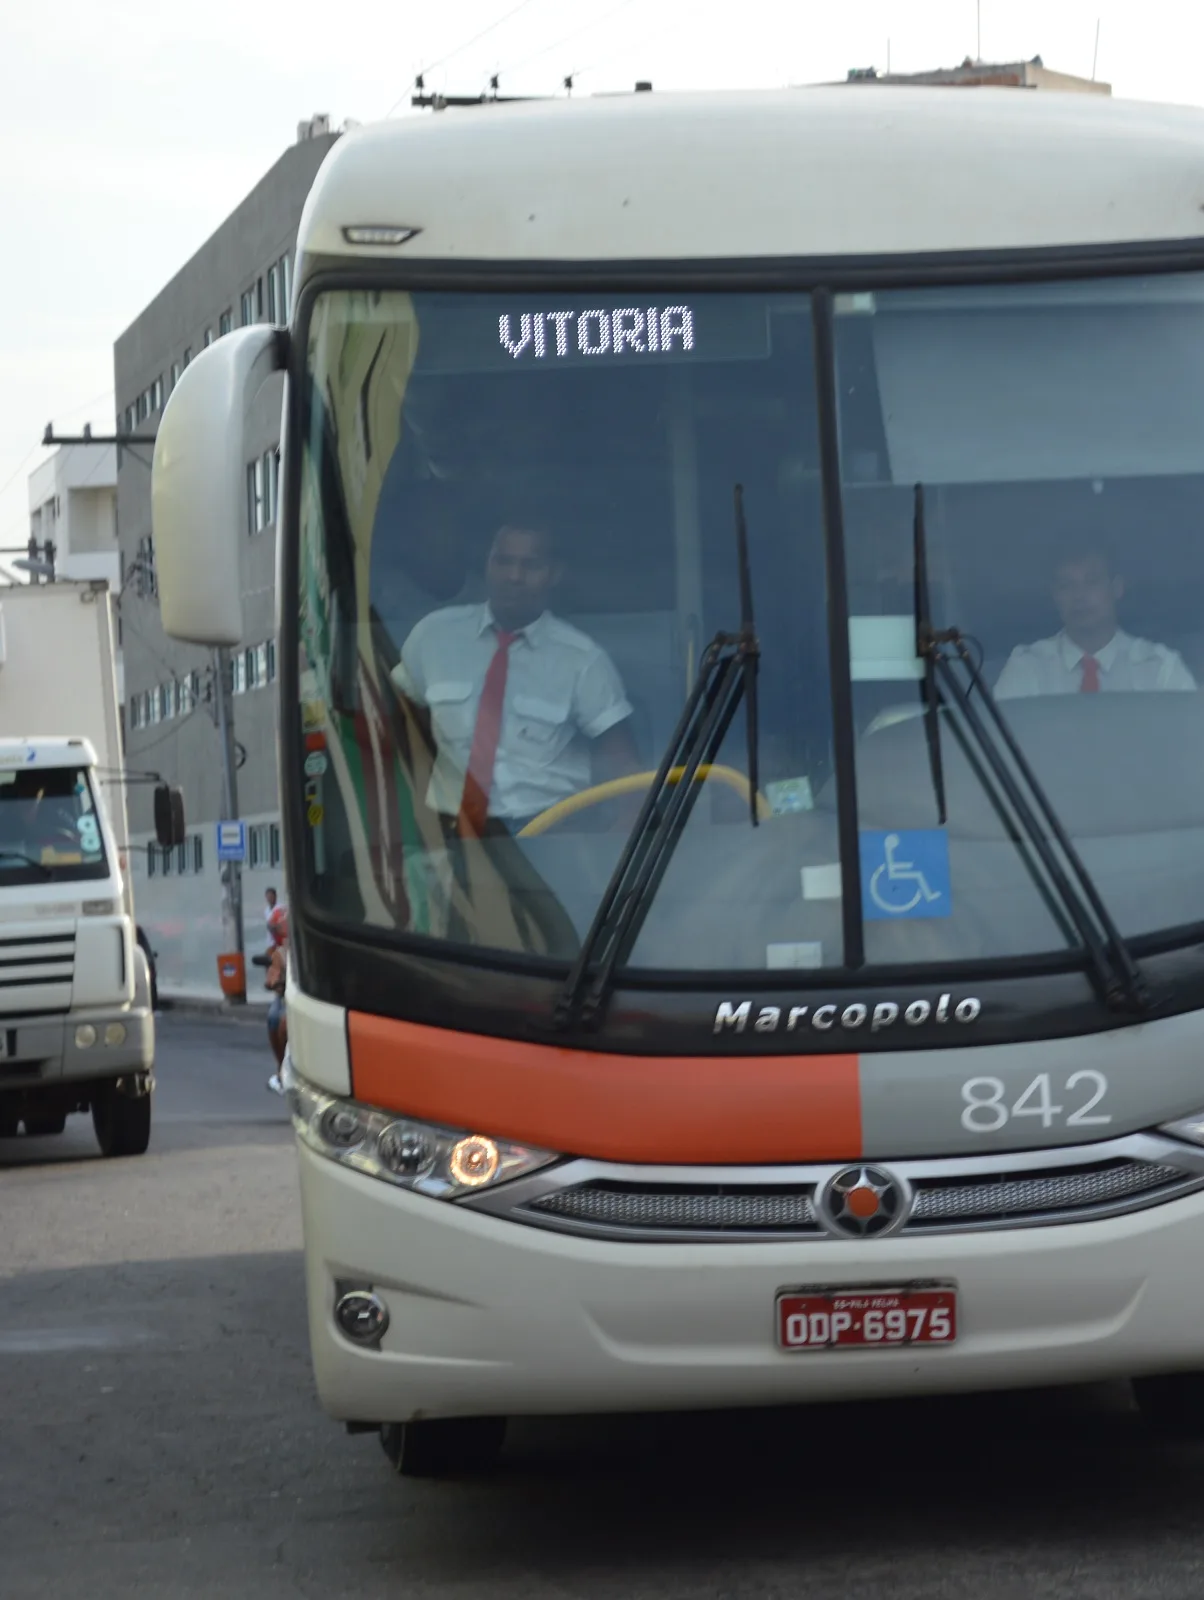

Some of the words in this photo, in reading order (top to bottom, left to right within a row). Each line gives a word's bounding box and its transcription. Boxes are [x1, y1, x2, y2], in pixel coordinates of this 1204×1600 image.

[499, 305, 694, 358] VITORIA
[713, 993, 981, 1034] Marcopolo
[960, 1069, 1112, 1133] 842
